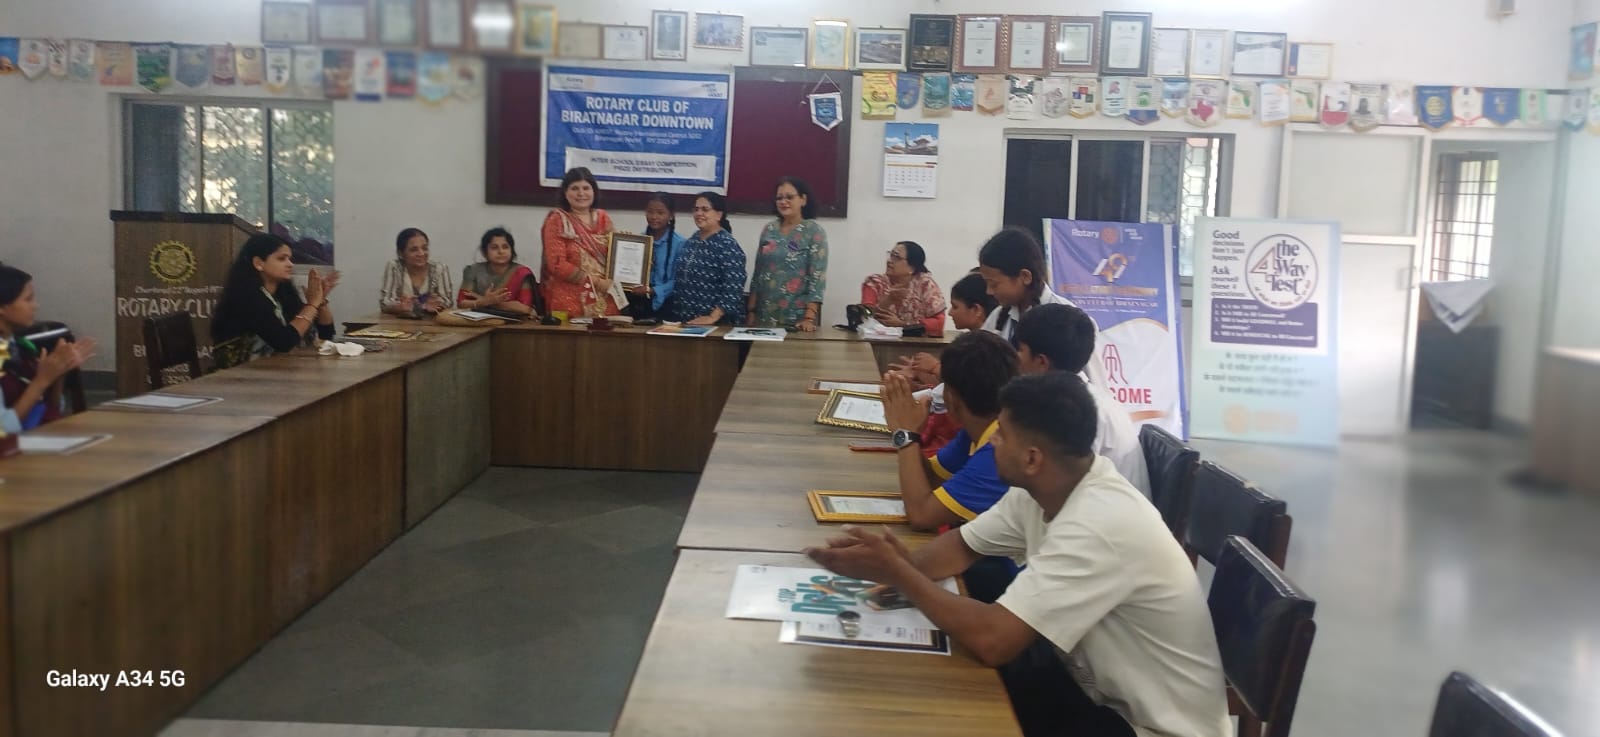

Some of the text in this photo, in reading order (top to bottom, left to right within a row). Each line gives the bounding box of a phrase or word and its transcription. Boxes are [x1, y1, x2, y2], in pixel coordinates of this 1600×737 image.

[586, 96, 689, 114] ROTARY CLUB OF
[561, 110, 714, 130] BIRATNAGAR DOWNTOWN
[1071, 228, 1100, 239] Rotary
[1212, 229, 1240, 239] Good
[1276, 239, 1300, 259] the
[1211, 265, 1230, 275] Ask
[1249, 245, 1309, 279] 4 Way
[1266, 274, 1304, 295] Test
[117, 297, 183, 317] ROTARY
